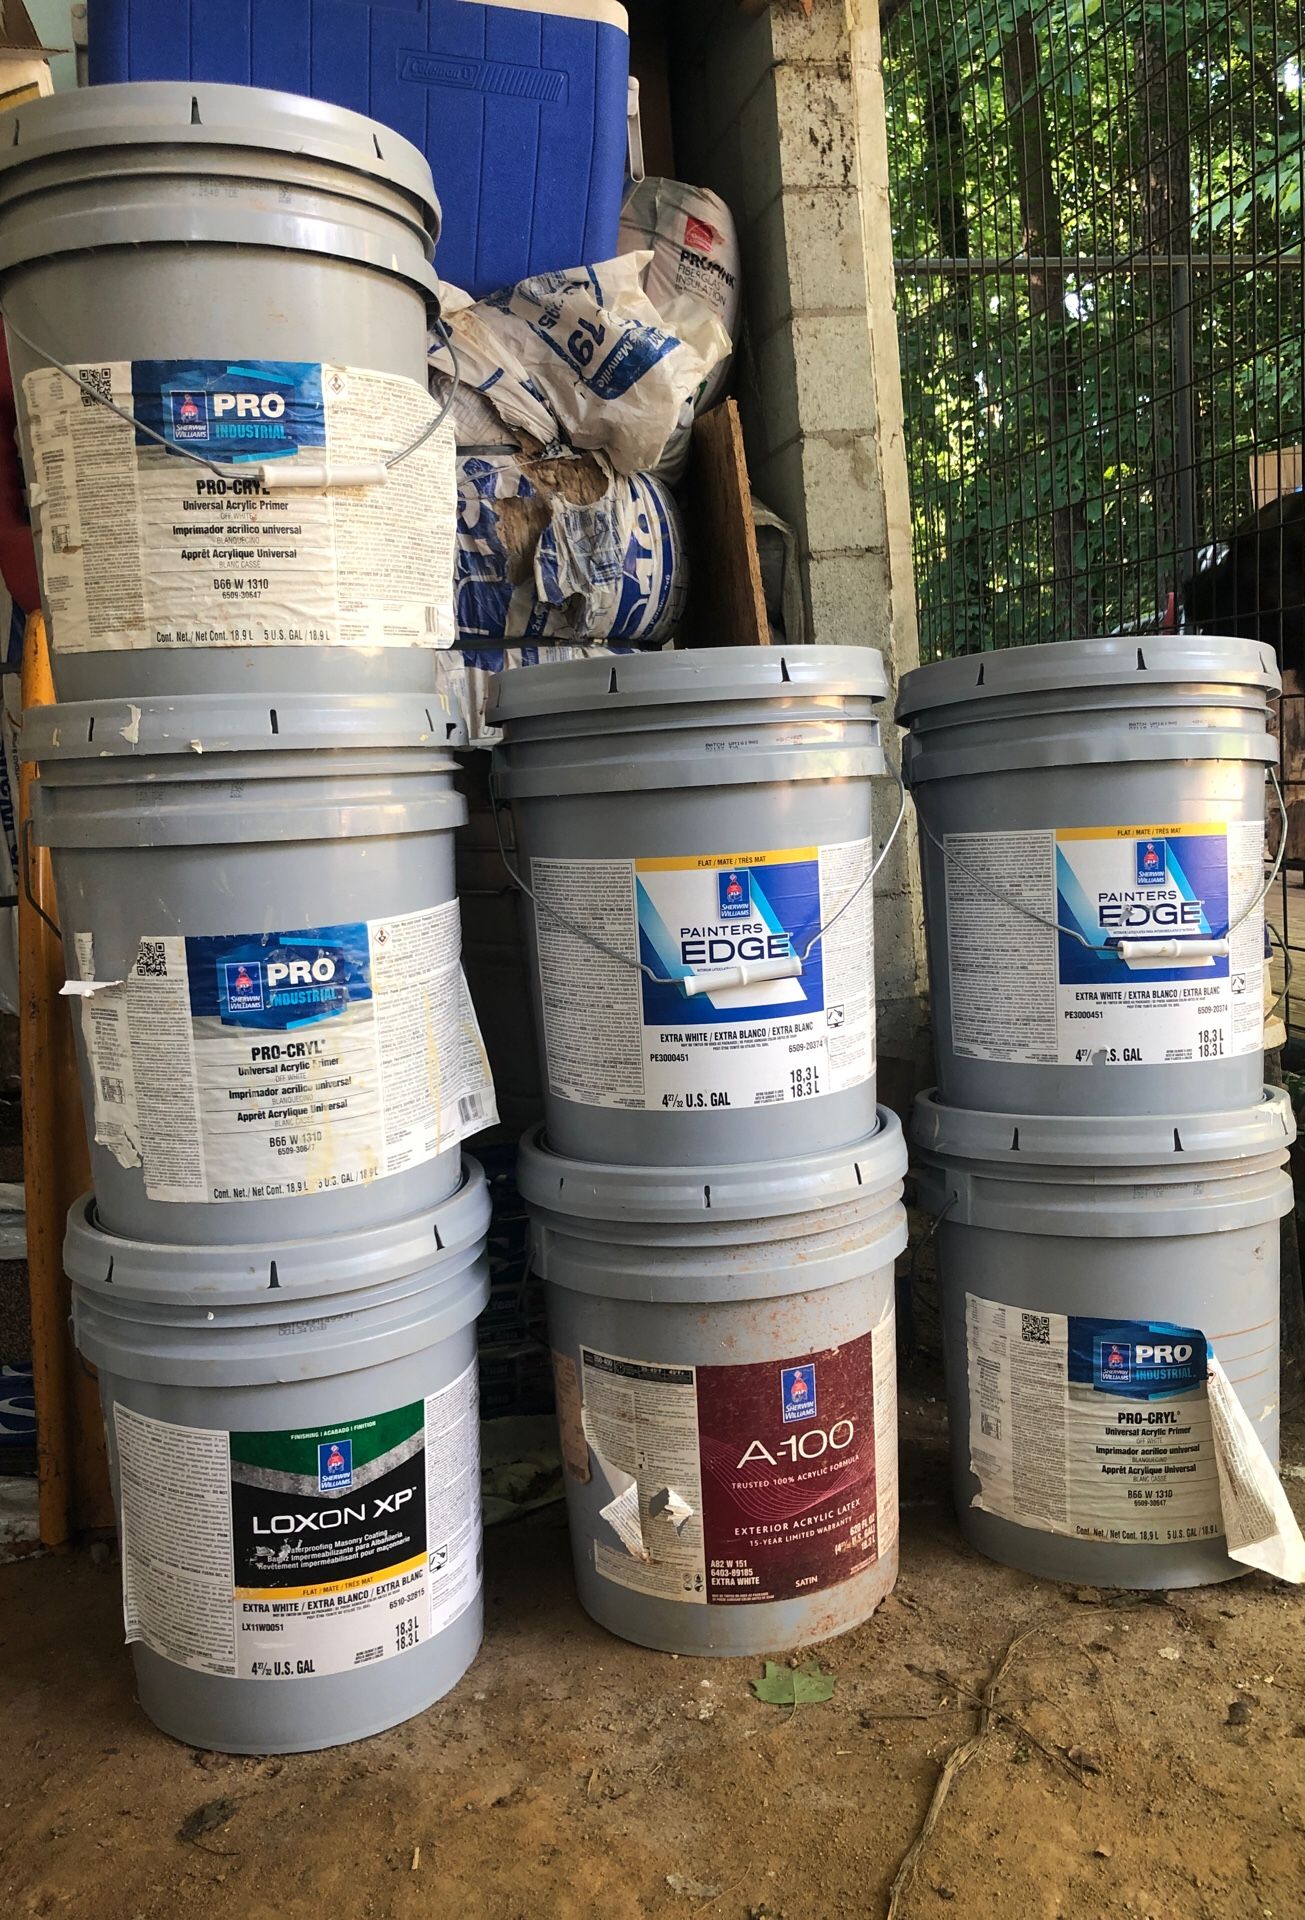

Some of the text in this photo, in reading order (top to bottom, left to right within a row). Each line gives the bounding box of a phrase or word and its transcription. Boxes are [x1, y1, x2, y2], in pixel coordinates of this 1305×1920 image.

[597, 341, 634, 388] Manville
[213, 392, 286, 419] PRO
[175, 430, 207, 438] WILLIAMS
[176, 424, 206, 432] SHERWIN
[215, 423, 286, 439] INDUSTRIAL
[183, 500, 289, 512] Universal Acrylic Primer
[173, 525, 223, 537] Imprimador
[262, 525, 302, 535] universal
[181, 548, 297, 561] Apprêt Acrylique Universal
[213, 579, 269, 590] B66 W 1310
[1117, 829, 1131, 837] FLAT
[738, 855, 754, 864] TRÈS
[1099, 890, 1177, 903] PAINTERS
[721, 909, 750, 917] WILLIAMS
[1100, 902, 1201, 927] EDGE
[680, 923, 763, 938] PAINTERS
[681, 933, 790, 965] EDGE
[267, 957, 336, 987] PRO
[230, 995, 261, 1003] SHERWIN
[271, 987, 337, 1007] INDUSTRIAL
[1075, 986, 1220, 1000] EXTRA WHITE EXTRA BLANCO EXTRA BLANC
[230, 1001, 261, 1010] WILLIAMS
[1064, 1011, 1103, 1019] PE3000451
[660, 1033, 683, 1043] EXTRA
[685, 1032, 708, 1042] WHITE
[714, 1030, 738, 1041] EXTRA
[739, 1028, 767, 1039] BLANCO
[772, 1023, 793, 1035] EXTRA
[794, 1021, 813, 1033] BLANC
[251, 1039, 323, 1061] PRO-CRYL
[788, 1039, 823, 1053] 6509-20374
[1198, 1044, 1218, 1057] 18.3
[650, 1053, 689, 1062] PE3000451
[1123, 1048, 1142, 1061] GAL
[238, 1060, 310, 1077] Universal Acrylic
[229, 1088, 279, 1101] Imprimador
[315, 1076, 352, 1091] universal
[790, 1083, 812, 1098] 18.3
[686, 1092, 731, 1107] U.S. GAL
[237, 1110, 266, 1123] Apprêt
[268, 1105, 309, 1119] Acrylique
[269, 1136, 287, 1148] B66
[289, 1135, 300, 1146] W
[1135, 1344, 1193, 1364] PRO
[1102, 1373, 1129, 1381] WILLIAMS
[1136, 1367, 1191, 1381] INDUSTRIAL
[785, 1401, 814, 1412] SHERWIN
[785, 1409, 815, 1420] WILLIAMS
[1118, 1411, 1177, 1425] PRO-CRYL
[291, 1420, 376, 1440] FINISHING ACABADO FINITION
[1105, 1427, 1191, 1437] Universal Acrylic Primer
[737, 1420, 854, 1469] A-100
[1095, 1445, 1139, 1456] Imprimador
[1169, 1444, 1200, 1455] universal
[732, 1454, 859, 1490] TRUSTED 100% ACRYLIC FORMULA
[1102, 1464, 1196, 1476] Apprêt Acrylique Universal
[321, 1472, 351, 1483] SHERWIN
[321, 1478, 351, 1489] WILLIAMS
[1128, 1489, 1173, 1499] B66 W 1310
[252, 1489, 413, 1535] LOXON XP
[734, 1498, 861, 1536] EXTERIOR ACRYLIC LATEX
[334, 1537, 363, 1548] Masonry
[364, 1529, 388, 1541] Coating
[750, 1516, 853, 1547] 15-YEAR LIMITED WARRANTY
[291, 1547, 354, 1562] Impermeabilizante
[355, 1542, 370, 1552] para
[300, 1553, 359, 1568] imperméabilisant
[360, 1549, 375, 1559] pour
[376, 1536, 411, 1553] maçonnerie
[710, 1560, 724, 1568] A82
[726, 1559, 733, 1568] W
[303, 1588, 317, 1596] FLAT
[323, 1585, 339, 1593] MATE
[361, 1577, 374, 1585] MAT
[711, 1576, 760, 1586] EXTRA WHITE
[795, 1575, 818, 1588] SATIN
[243, 1569, 423, 1613] EXTRA WHITE EXTRA BLANCO EXTRA BLANC
[242, 1623, 284, 1632] LX11W0051
[396, 1633, 413, 1651] 18.3
[274, 1660, 315, 1675] U.S. GAL
